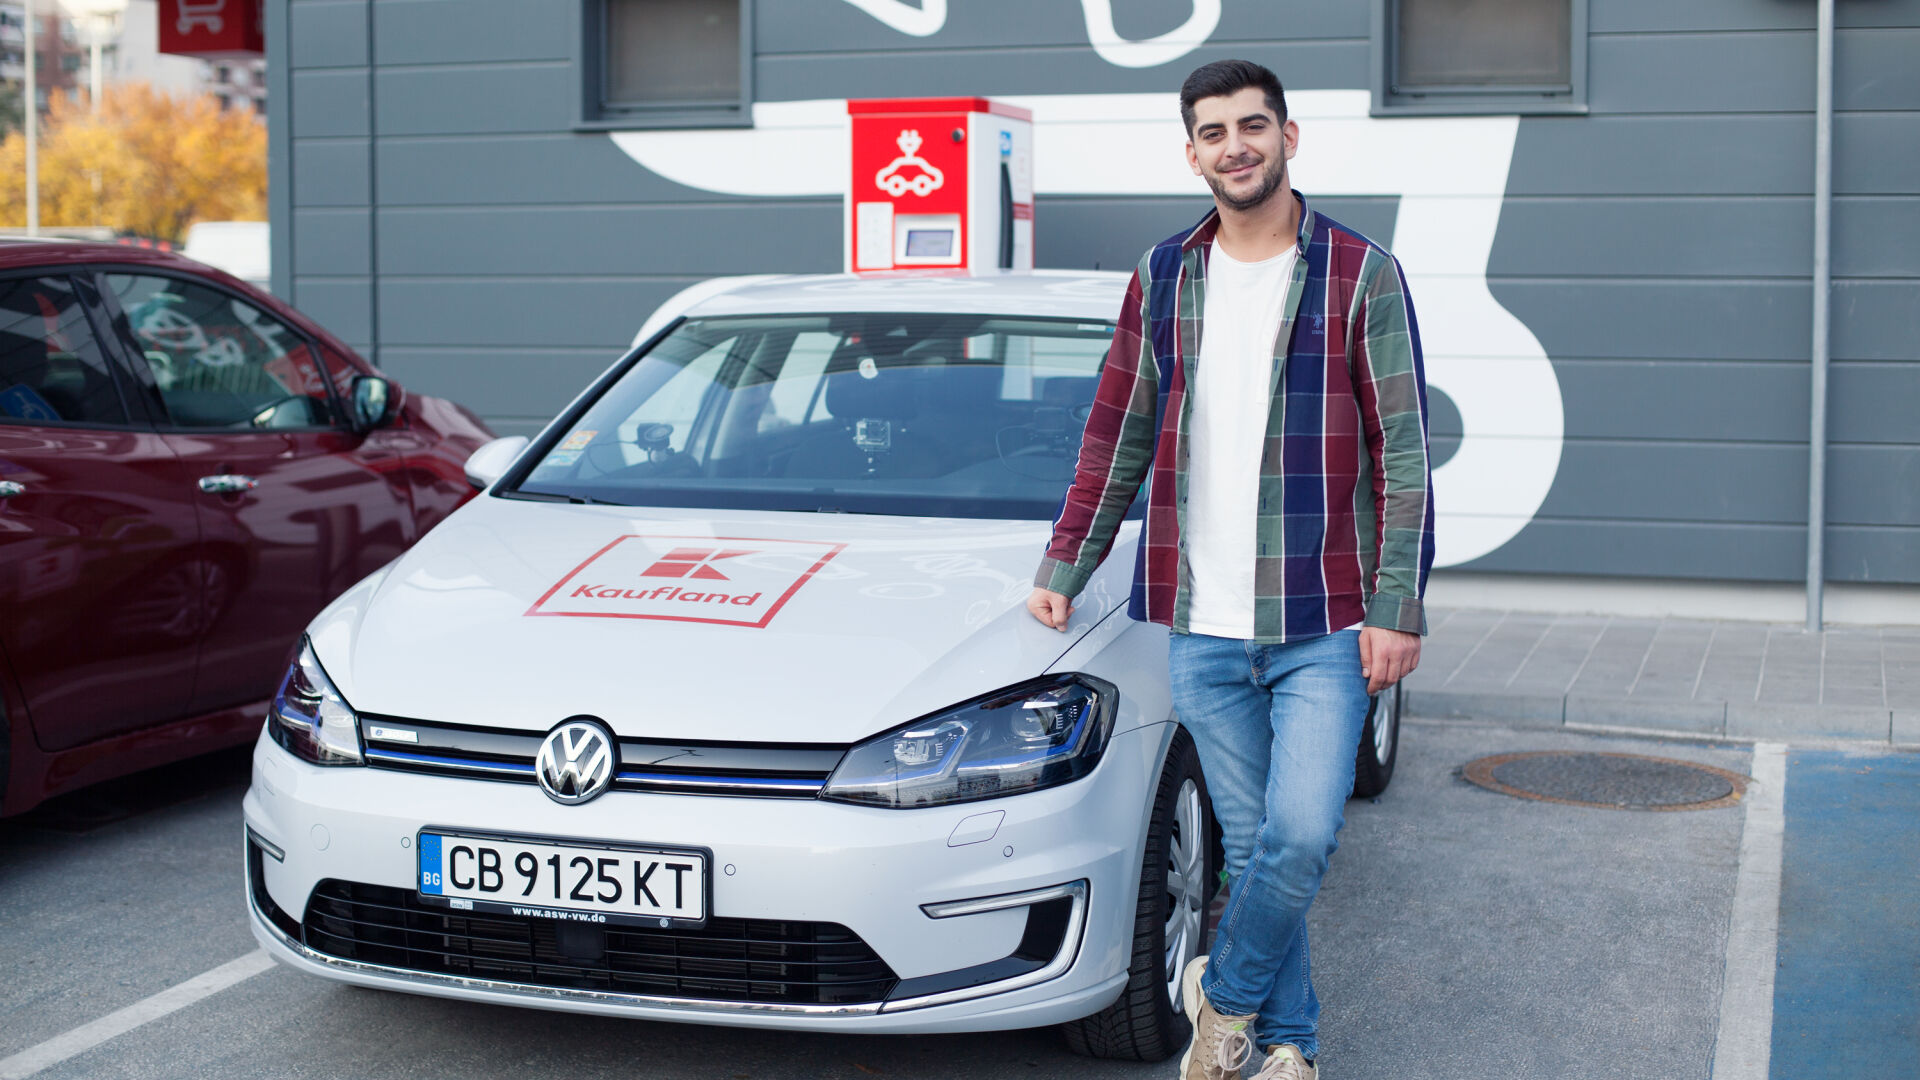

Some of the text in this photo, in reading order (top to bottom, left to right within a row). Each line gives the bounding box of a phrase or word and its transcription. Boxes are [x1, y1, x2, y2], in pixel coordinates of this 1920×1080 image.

[570, 584, 763, 607] Kaufland
[423, 872, 441, 886] BG
[449, 845, 694, 910] CB 9125 KT
[512, 907, 607, 923] www.asw-vw.de
